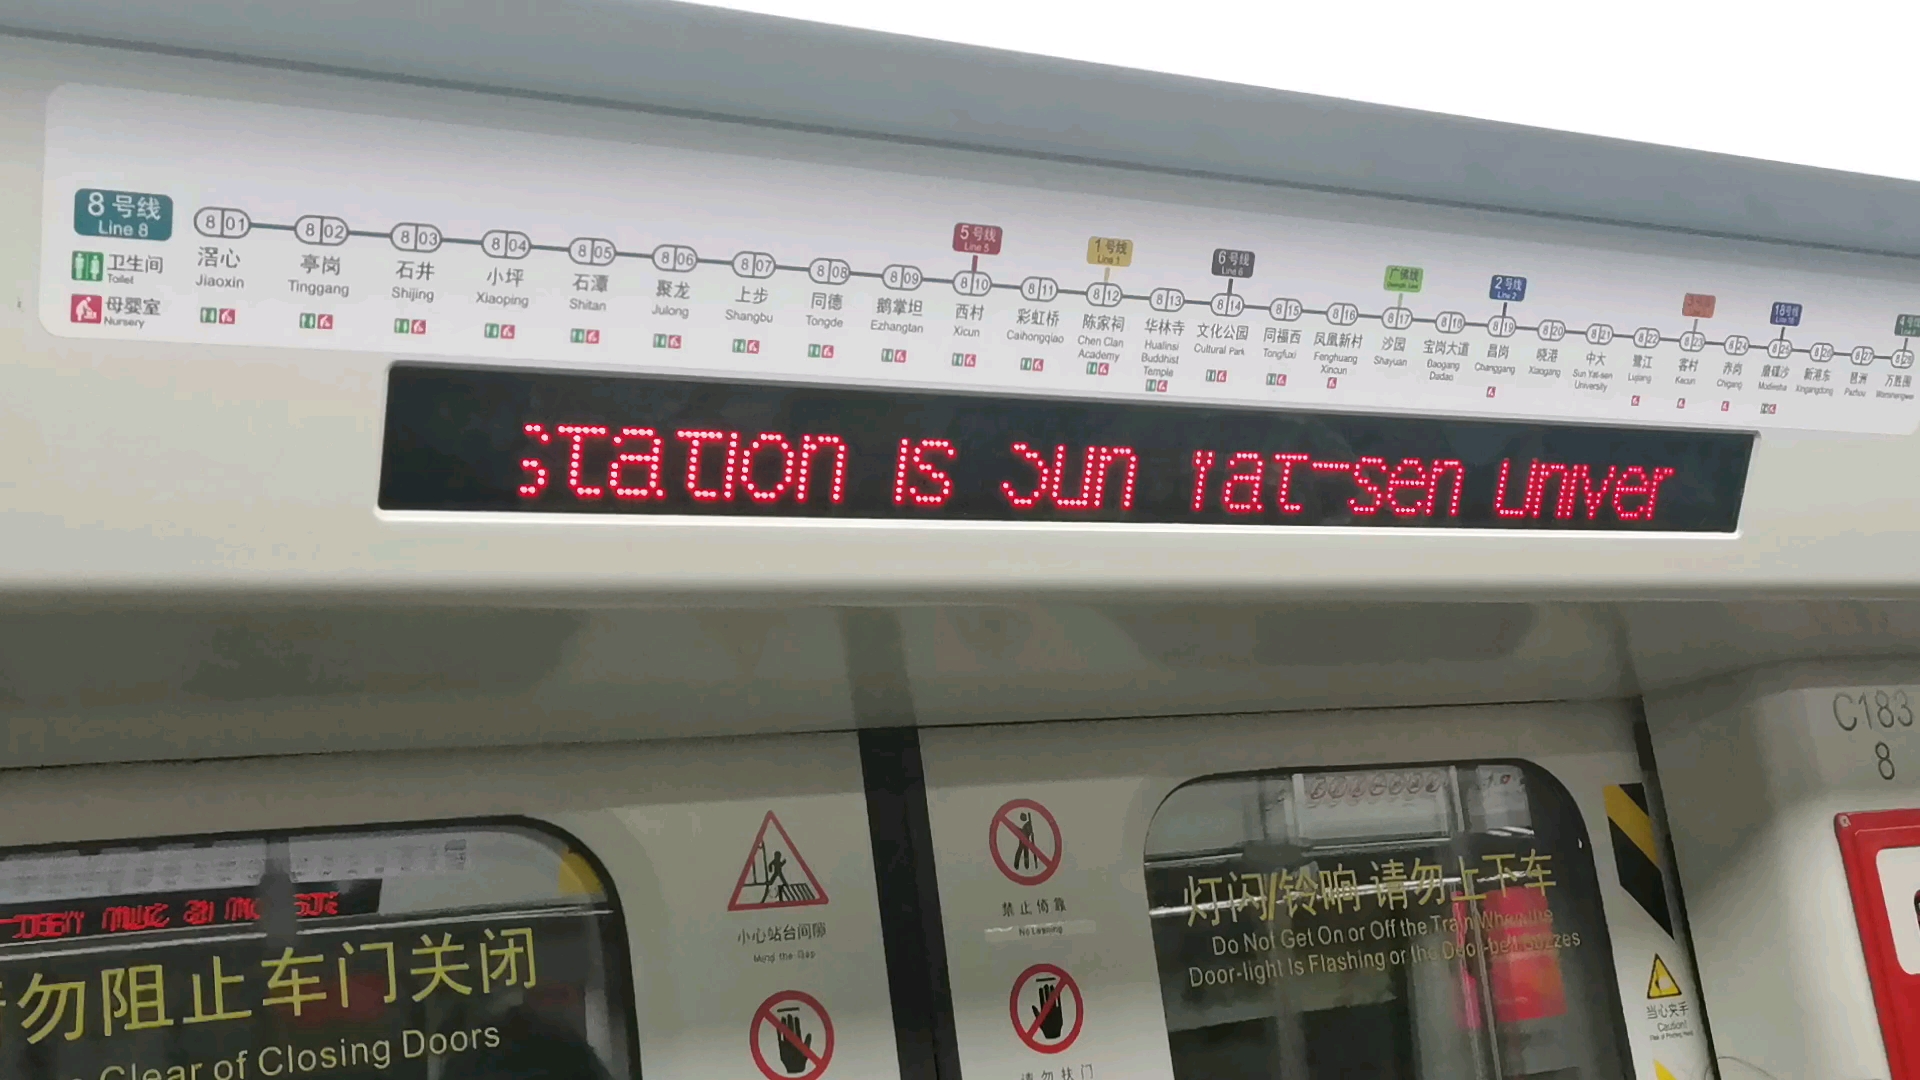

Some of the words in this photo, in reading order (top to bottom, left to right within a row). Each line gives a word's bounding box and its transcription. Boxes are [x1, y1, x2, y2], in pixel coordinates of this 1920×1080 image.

[98, 220, 133, 237] Line
[138, 223, 149, 237] 8
[964, 242, 980, 252] Line
[108, 254, 164, 274] 卫生间
[300, 254, 340, 276] 亭岗
[395, 260, 435, 281] 石井
[108, 273, 134, 285] Toilet
[195, 274, 245, 289] Jiaoxin
[486, 267, 524, 287] 小坪
[572, 273, 609, 293] 石潭
[288, 280, 350, 297] Tinggang
[391, 287, 435, 303] Shijing
[655, 279, 691, 300] 聚龙
[735, 285, 769, 305] 上步
[105, 296, 161, 317] 母婴室
[476, 291, 529, 309] Xiaoping
[569, 298, 607, 312] Shitan
[811, 292, 843, 312] 同德
[876, 297, 923, 317] 鹅掌坦
[652, 304, 689, 319] Julong
[725, 309, 773, 324] Shangbu
[955, 303, 985, 322] 西村
[1016, 308, 1060, 328] 彩虹桥
[104, 316, 145, 329] Nursery
[806, 315, 843, 329] Tongde
[870, 320, 924, 334] Ezhangtan
[1082, 313, 1125, 333] 陈家祠
[1144, 318, 1185, 335] 华林寺
[953, 325, 980, 338] Xicun
[1006, 330, 1065, 345] Caihongqiao
[1197, 322, 1249, 340] 文化公园
[1263, 327, 1302, 344] 同福西
[1077, 335, 1103, 346] Chen
[1104, 336, 1124, 348] Clan
[1145, 340, 1179, 351] Hualinsi
[1313, 331, 1363, 349] 凤凰新村
[1382, 336, 1406, 352] 沙园
[1423, 339, 1469, 357] 宝岗大道
[1078, 348, 1120, 362] Academy
[1194, 343, 1227, 354] Cultural
[1228, 346, 1245, 356] Park
[1263, 348, 1297, 360] Tongfuxi
[1487, 343, 1509, 359] 昌岗
[1536, 348, 1558, 363] 晓港
[1141, 352, 1179, 365] Buddhist
[1313, 352, 1358, 365] Fenghuang
[1374, 355, 1407, 368] Shayuan
[1586, 351, 1606, 366] 中大
[1678, 358, 1698, 372] 客村
[1144, 366, 1174, 378] Temple
[1320, 365, 1347, 375] Xincun
[1528, 366, 1561, 379] Xiaogang
[1573, 369, 1587, 378] Sun
[1574, 380, 1607, 392] University
[892, 436, 957, 504] is
[1001, 442, 1138, 509] Sun
[1191, 449, 1464, 517] Yat-sen
[1494, 458, 1676, 520] Univer
[1832, 689, 1914, 731] C183
[1875, 741, 1895, 780] 8
[1370, 849, 1556, 910] 请勿上下车
[738, 922, 827, 945] 小心站台间隙
[1212, 933, 1239, 955] Do
[1244, 928, 1276, 952] Not
[1281, 922, 1314, 947] Get
[1318, 922, 1344, 944] On
[1348, 925, 1366, 942] or
[1370, 912, 1397, 939] Off
[1401, 914, 1427, 936] the
[754, 952, 775, 963] Mind
[779, 952, 793, 960] the
[1189, 956, 1282, 988] Door-light
[1289, 958, 1304, 977] Is
[1309, 944, 1385, 974] Flashing
[1389, 948, 1407, 965] or
[0, 927, 538, 1044] 勿阻止车门关闭
[1646, 1001, 1689, 1019] 当心夹手
[100, 1060, 202, 1080] Clear
[214, 1051, 247, 1080] of
[259, 1038, 391, 1076] Closing
[402, 1026, 500, 1059] Doors
